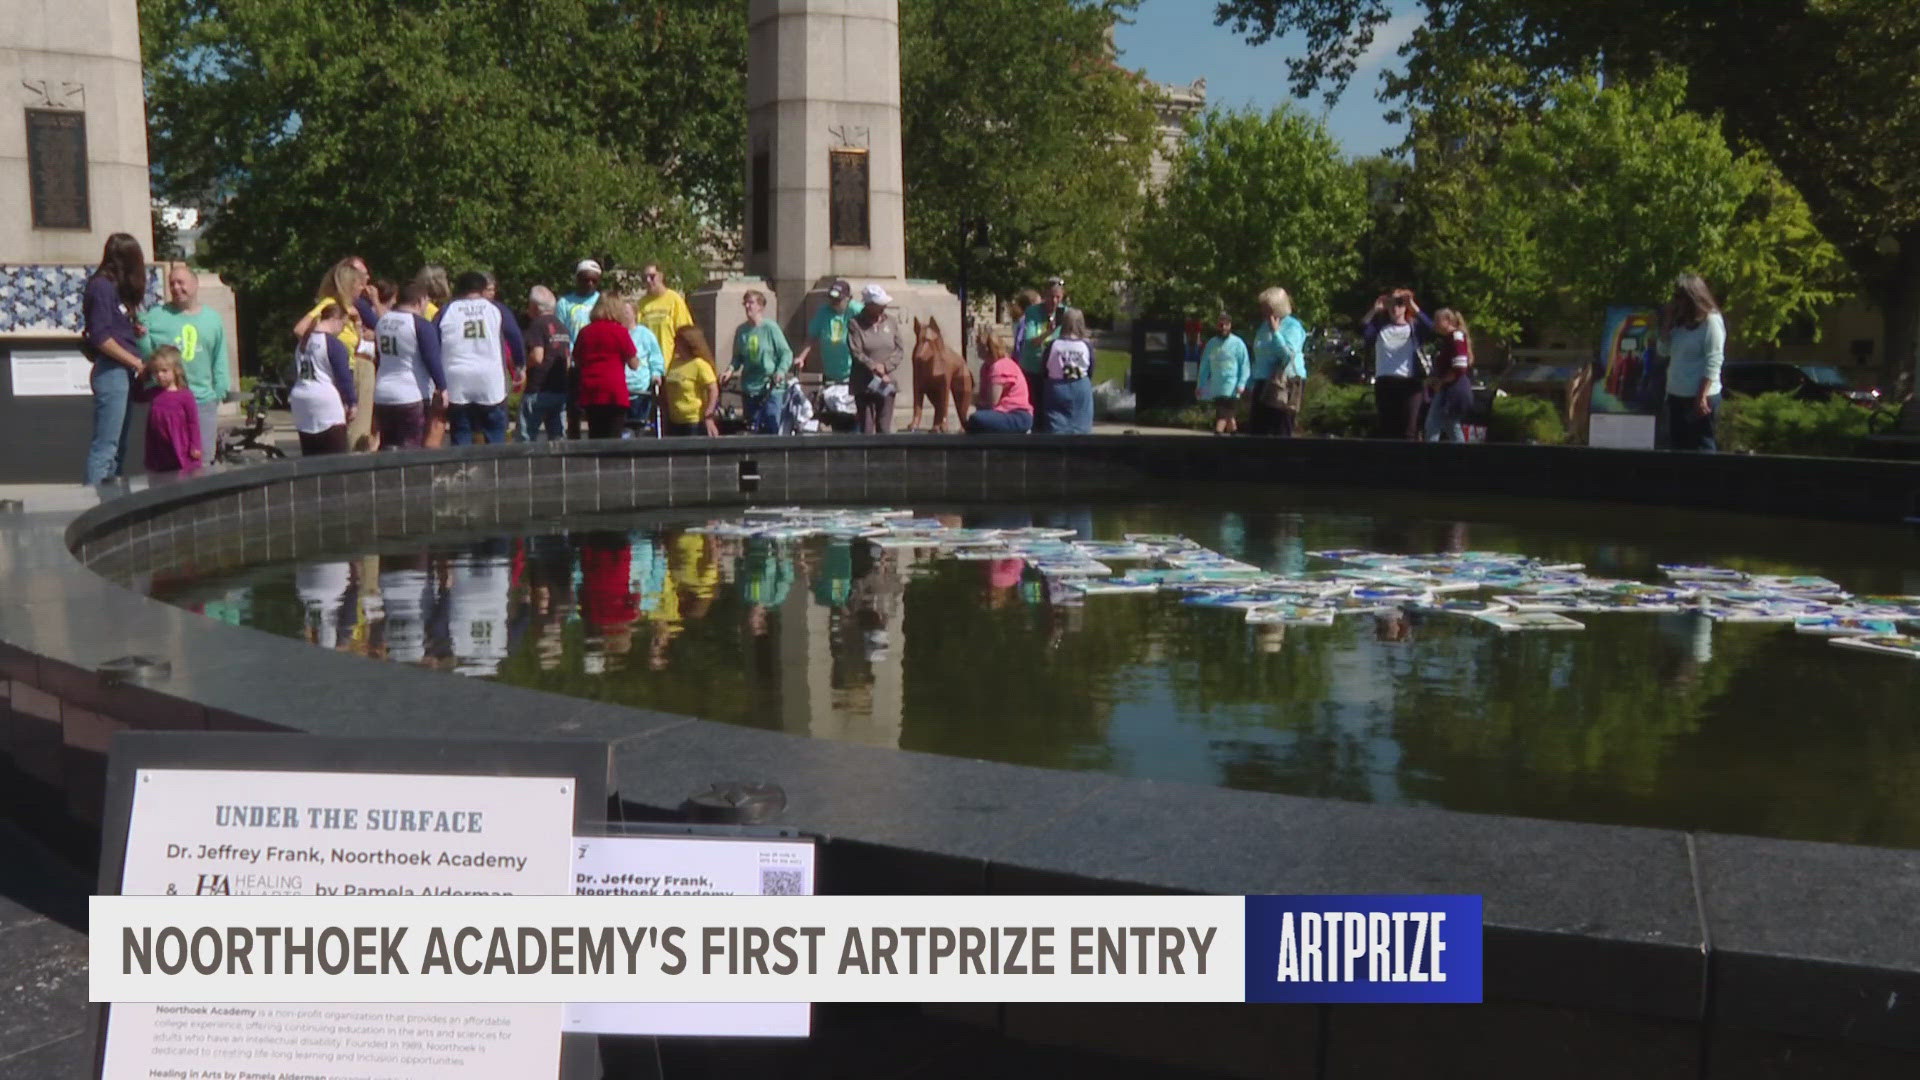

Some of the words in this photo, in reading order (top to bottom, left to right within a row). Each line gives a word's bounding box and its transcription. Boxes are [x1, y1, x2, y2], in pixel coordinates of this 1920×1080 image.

[464, 320, 485, 338] 21
[216, 805, 300, 828] UNDER
[307, 808, 358, 830] THE
[366, 809, 483, 833] SURFACE
[166, 844, 192, 859] Dr.
[197, 844, 261, 864] Jeffrey
[266, 846, 325, 865] Frank,
[331, 848, 432, 866] Noorthoek
[437, 851, 527, 872] Academy
[166, 883, 178, 895] &
[235, 875, 303, 890] HEALING
[315, 882, 338, 895] by
[576, 873, 597, 884] Dr.
[601, 873, 659, 888] Jeffery
[664, 875, 714, 888] Frank,
[156, 1005, 208, 1015] Noorthoek
[210, 1006, 256, 1017] Academy
[324, 1011, 383, 1021] organization
[385, 1013, 405, 1022] that
[407, 1014, 448, 1024] provides
[463, 1016, 511, 1026] affordable
[154, 1020, 188, 1029] college
[285, 1023, 335, 1034] continuing
[338, 1025, 385, 1034] education
[388, 1027, 396, 1035] in
[399, 1027, 415, 1035] the
[416, 1029, 434, 1037] arts
[437, 1029, 455, 1038] and
[457, 1030, 497, 1040] sciences
[499, 1031, 511, 1040] for
[207, 1034, 229, 1043] have
[426, 1042, 476, 1052] Noorthoek
[295, 1051, 334, 1062] learning
[336, 1052, 354, 1061] and
[149, 1068, 187, 1079] Healing
[190, 1069, 199, 1078] in
[201, 1070, 221, 1079] Arts
[224, 1071, 236, 1080] by
